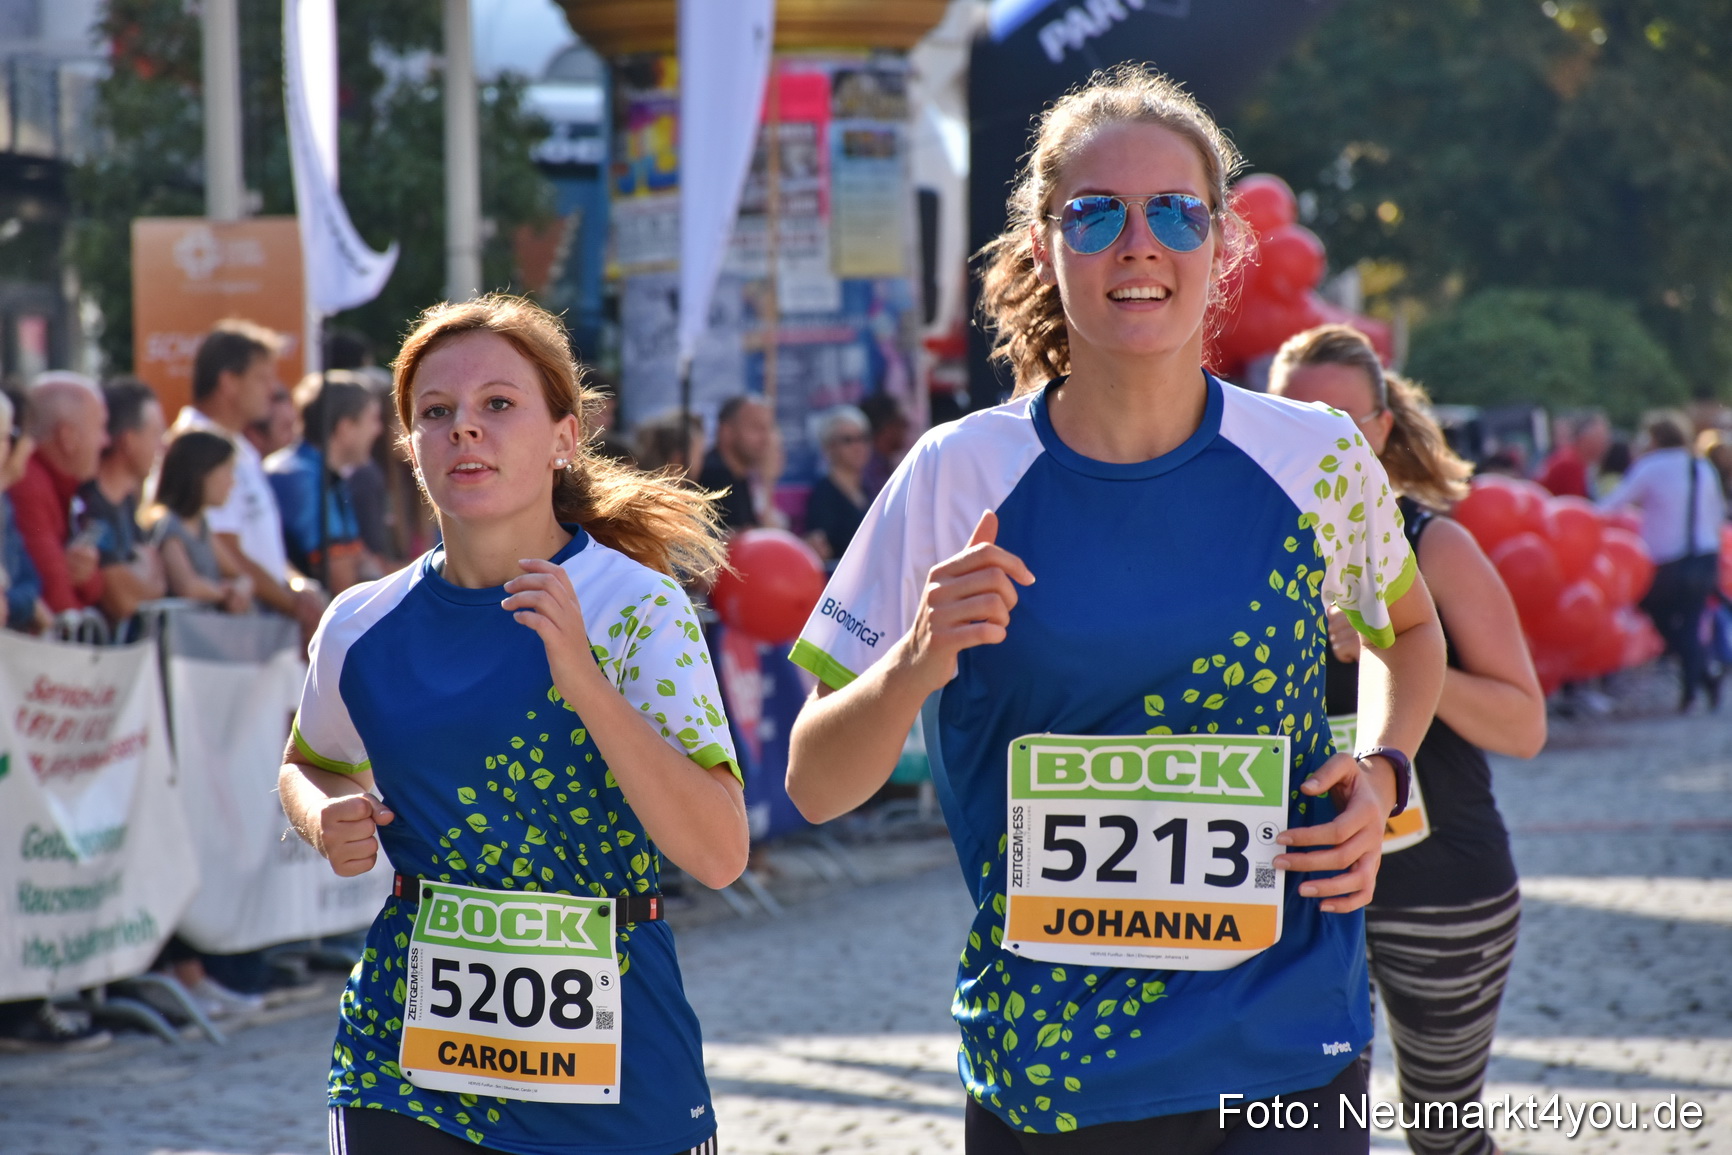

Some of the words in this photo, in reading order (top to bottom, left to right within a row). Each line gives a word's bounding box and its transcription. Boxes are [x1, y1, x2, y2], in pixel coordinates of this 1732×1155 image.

[1032, 746, 1262, 795] BOCK
[1041, 814, 1250, 888] 5213
[425, 894, 596, 949] BOCK
[1043, 908, 1242, 942] JOHANNA
[430, 957, 594, 1029] 5208
[437, 1040, 576, 1077] CAROLIN
